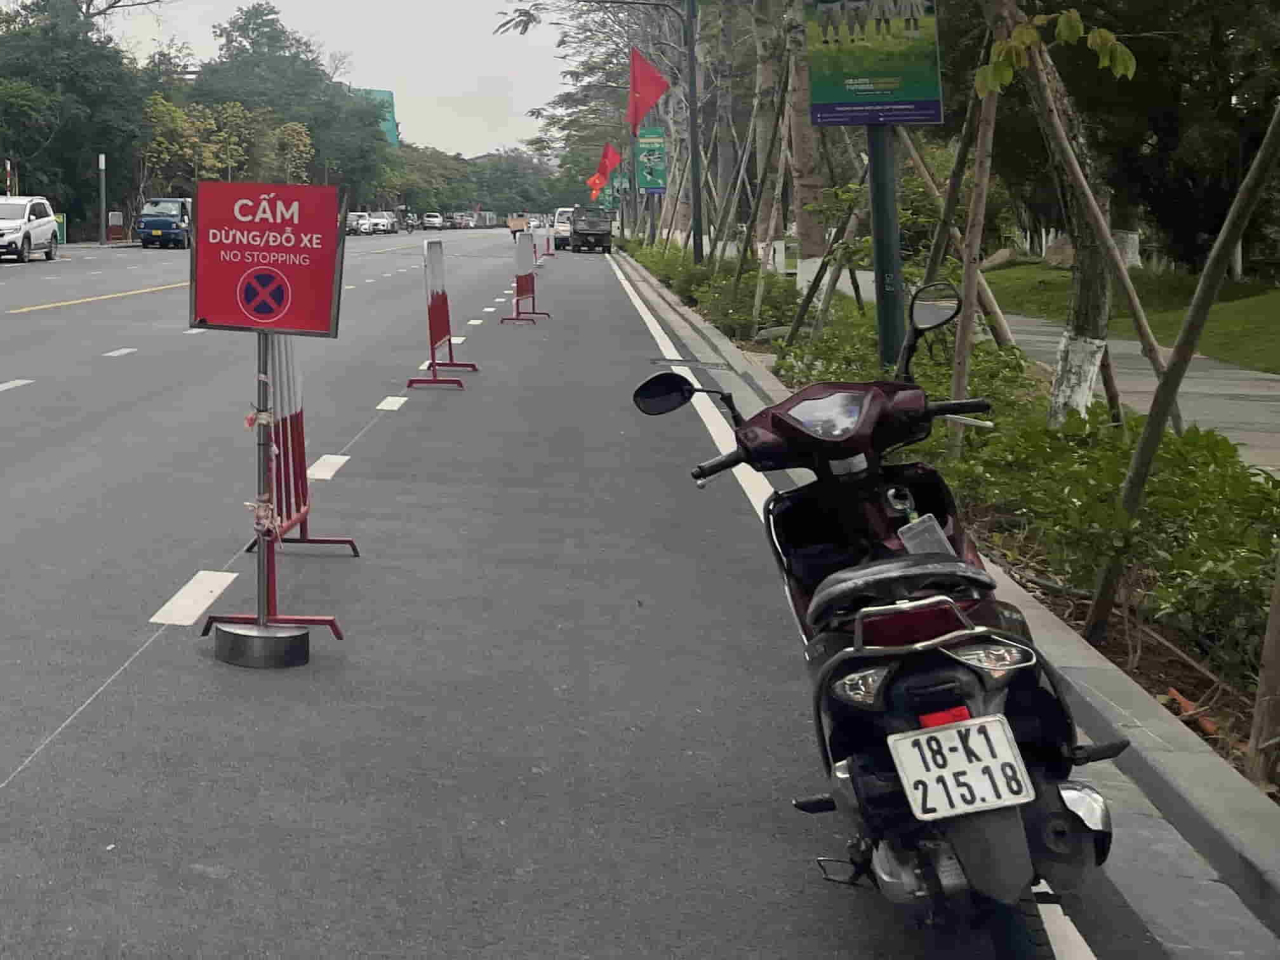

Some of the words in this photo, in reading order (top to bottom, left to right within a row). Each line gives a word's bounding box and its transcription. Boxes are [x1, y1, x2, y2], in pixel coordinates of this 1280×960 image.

[233, 192, 300, 224] CẤM
[208, 226, 295, 248] DỪNG/ĐỖ
[299, 232, 323, 249] XE
[220, 250, 241, 262] NO
[244, 250, 311, 266] STOPPING
[911, 724, 998, 773] 18-K1
[913, 761, 1024, 815] 215.18
